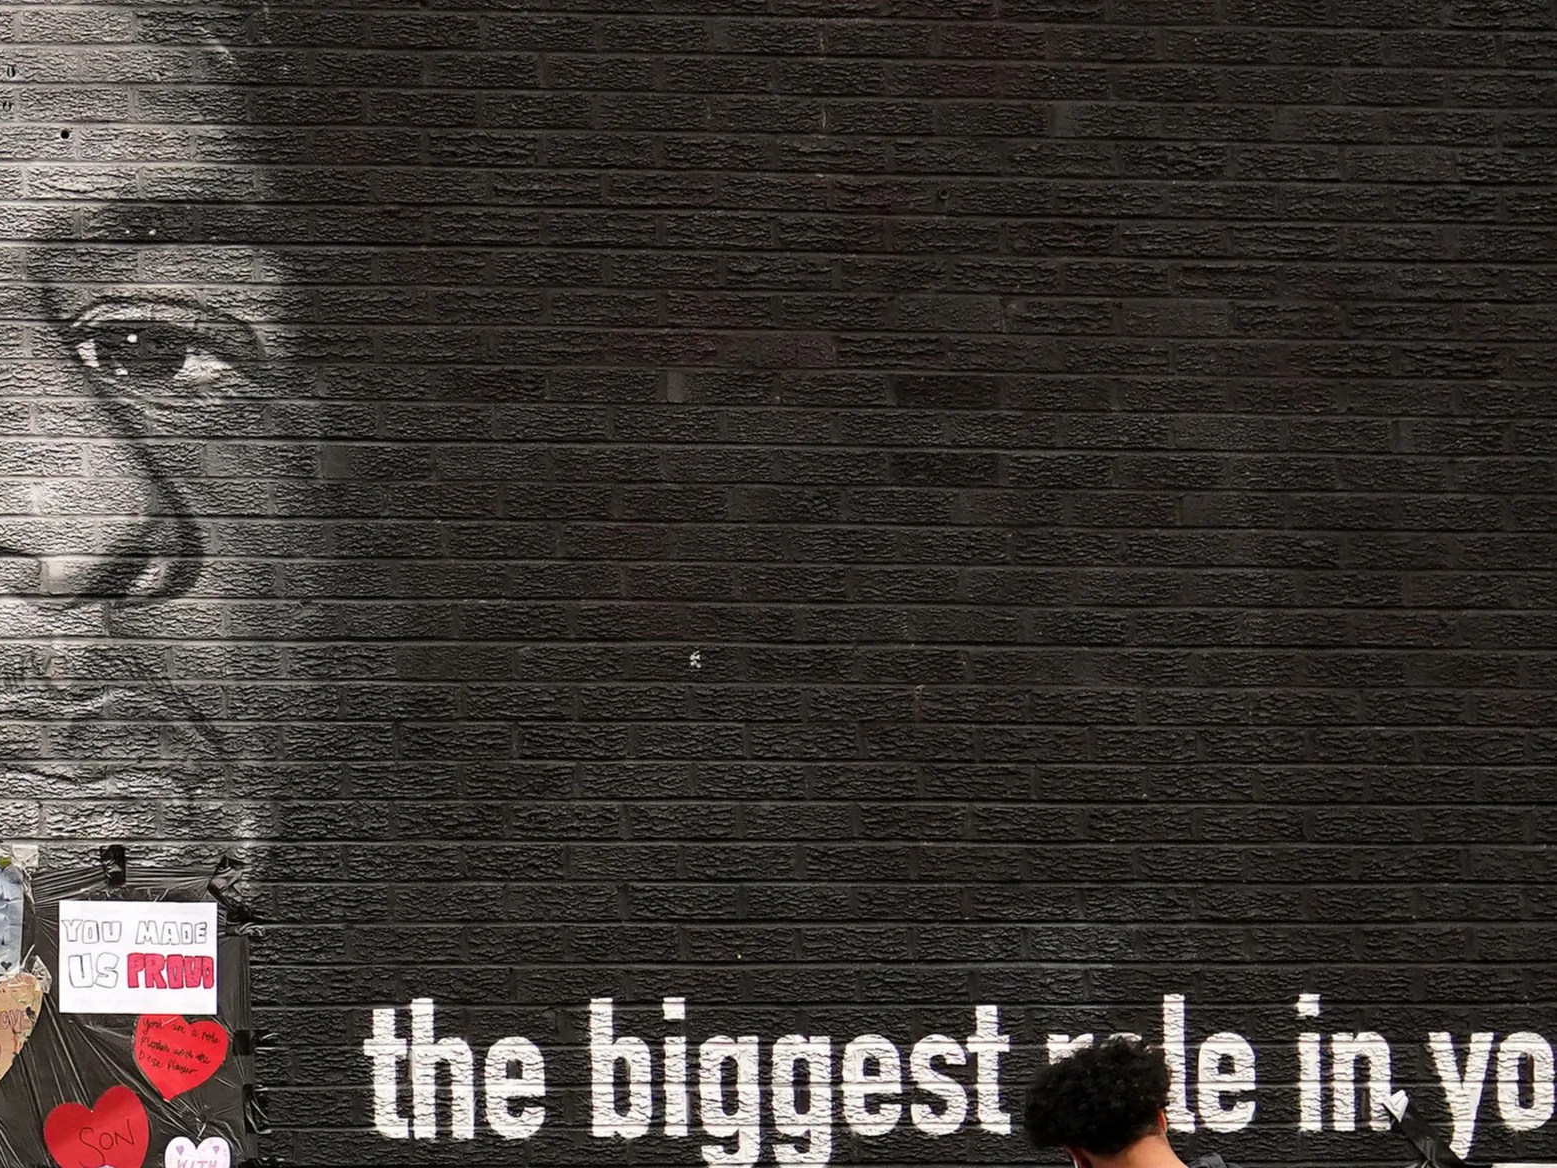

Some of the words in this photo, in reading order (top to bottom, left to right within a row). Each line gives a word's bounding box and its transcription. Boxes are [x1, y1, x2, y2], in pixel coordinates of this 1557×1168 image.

[61, 920, 122, 944] YOU
[135, 921, 207, 945] MADE
[68, 952, 119, 988] US
[127, 952, 214, 989] PROUD
[363, 997, 546, 1139] the
[1047, 993, 1256, 1133] le
[1295, 993, 1393, 1133] in
